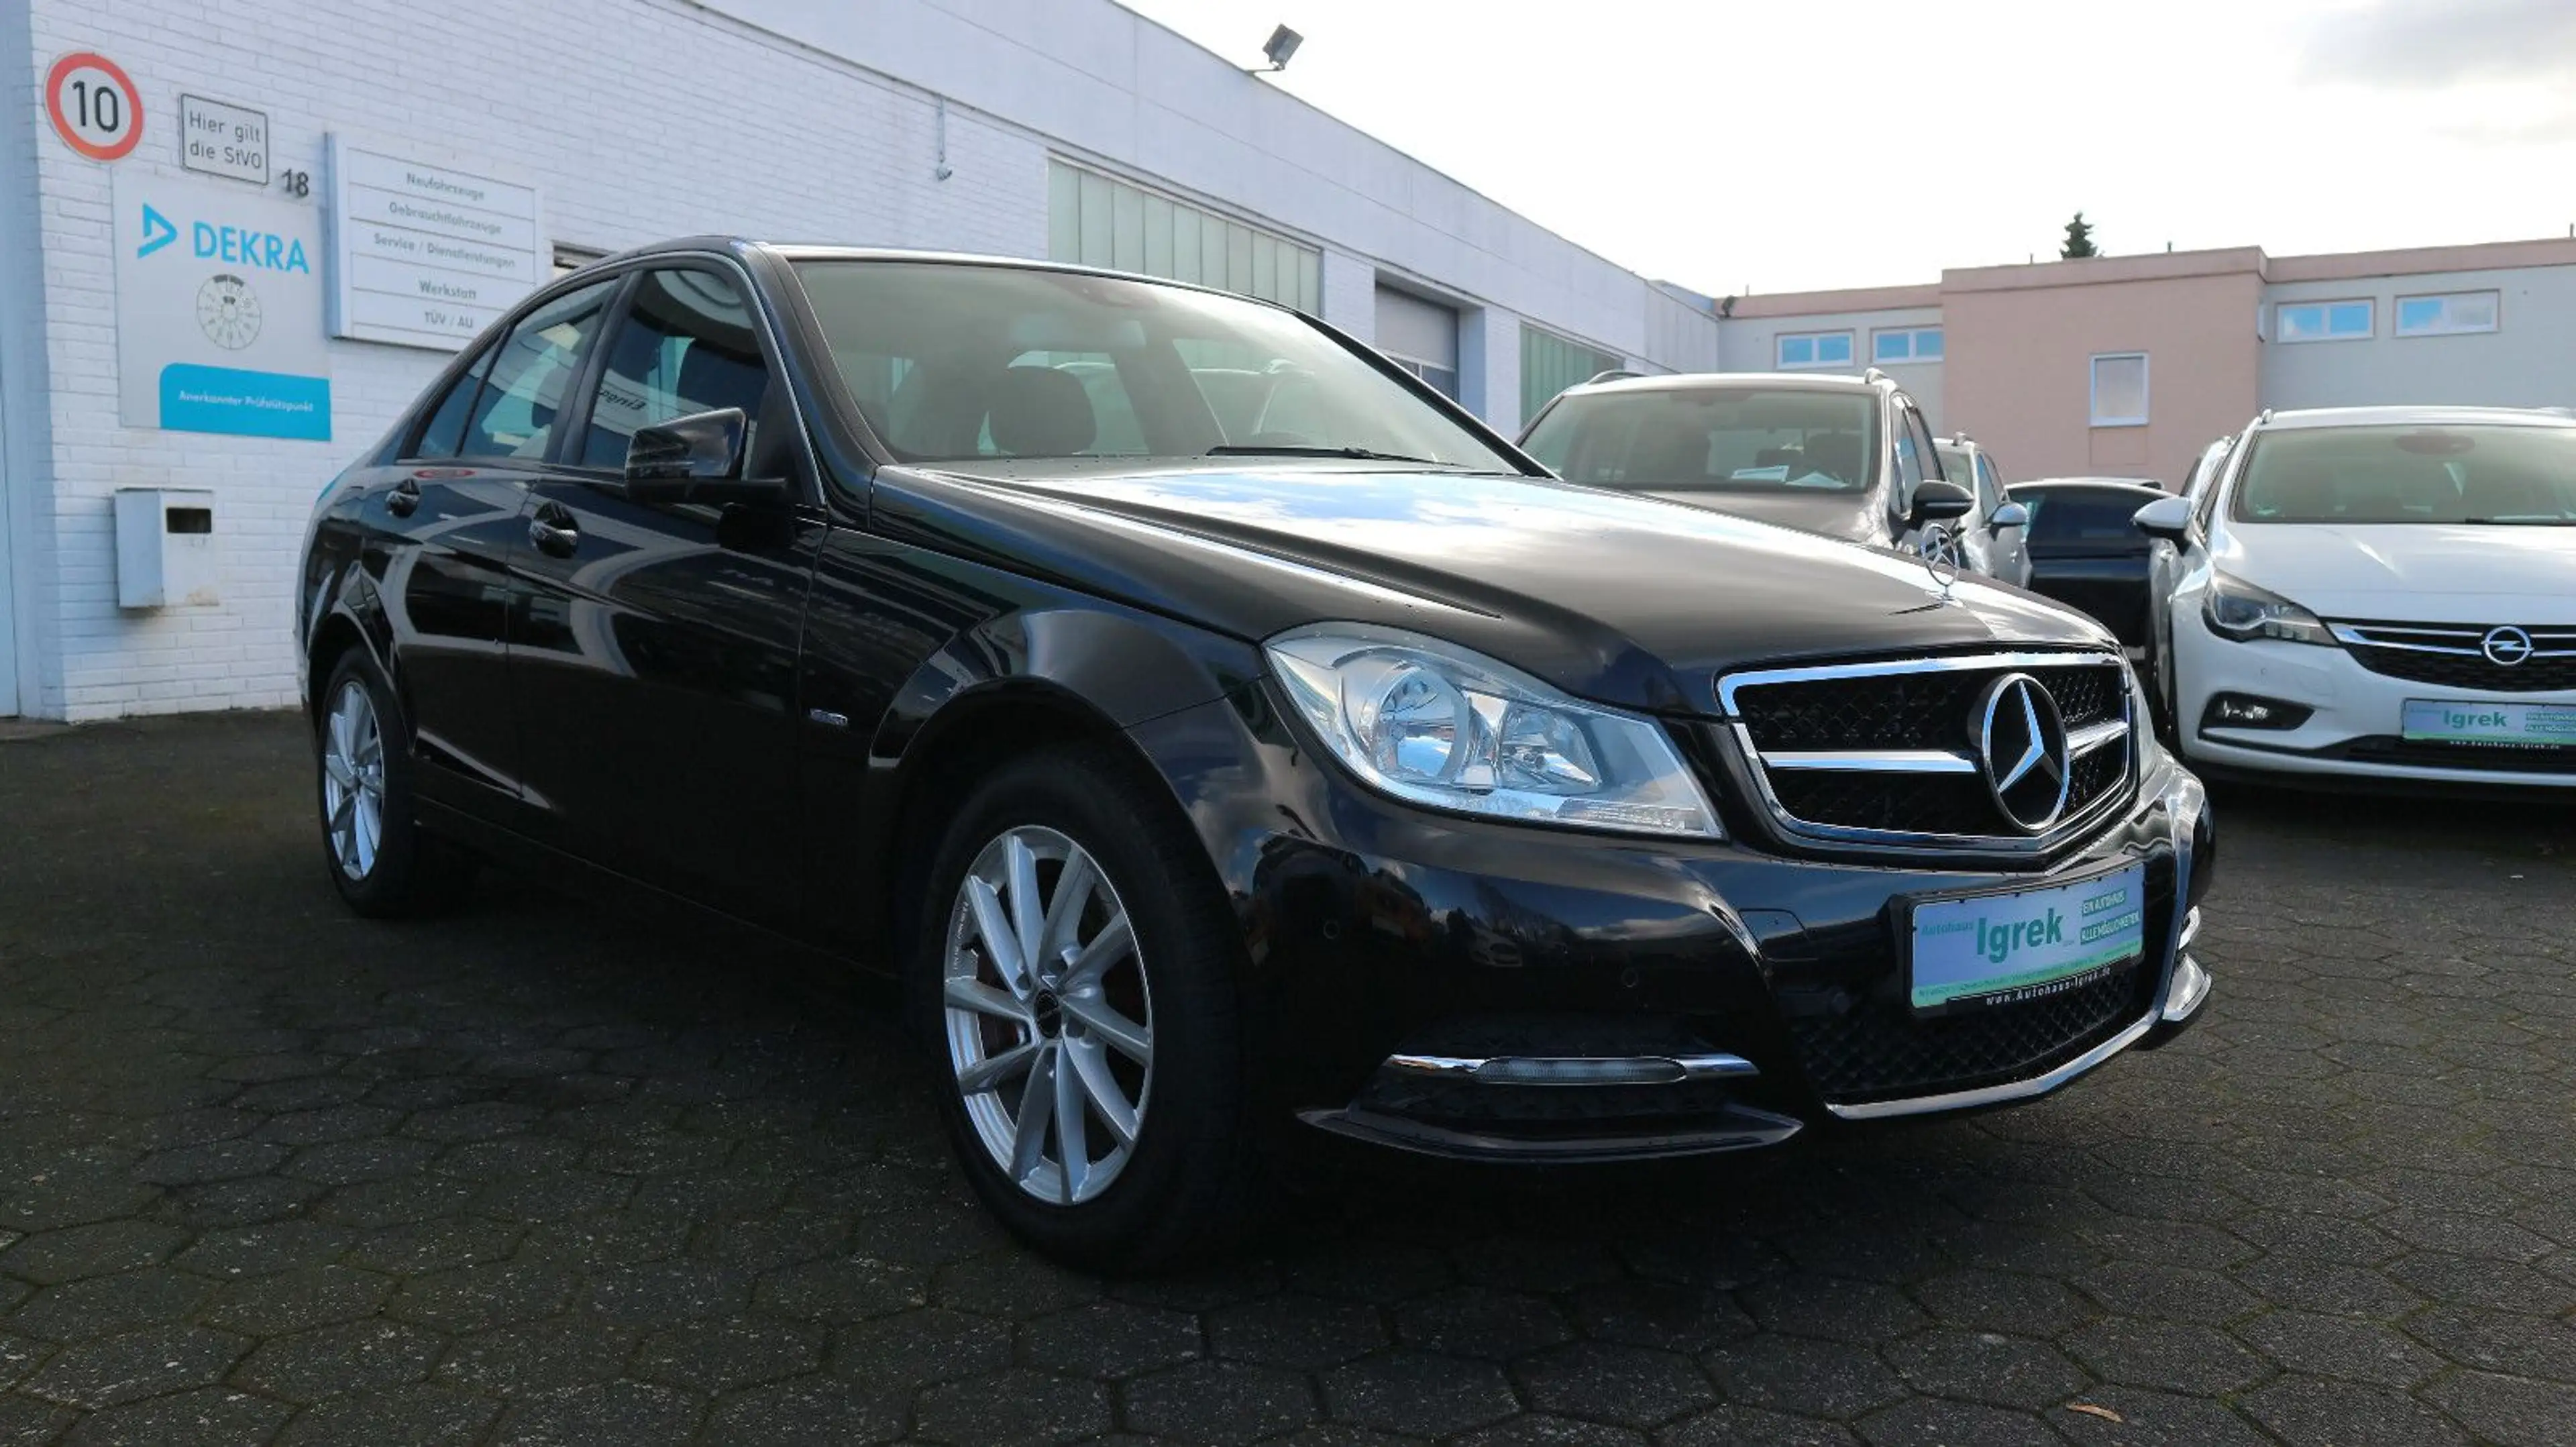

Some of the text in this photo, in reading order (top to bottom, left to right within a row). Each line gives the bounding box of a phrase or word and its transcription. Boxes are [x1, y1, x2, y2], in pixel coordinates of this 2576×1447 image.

[72, 80, 119, 133] 10
[189, 110, 260, 143] Hier gilt
[189, 140, 262, 169] die StVO
[282, 168, 309, 197] 18
[407, 172, 485, 201] Neufahrzeuge
[389, 201, 502, 235] Gebrauchtfahrzeuge
[193, 220, 310, 274] DEKRA
[374, 232, 415, 251] Service
[418, 279, 477, 299] Werkstatt
[425, 309, 446, 325] TÜV
[457, 315, 474, 329] AU
[2443, 710, 2508, 729] Igrek
[1921, 920, 1974, 935] Autohaus
[1976, 908, 2063, 963] Igrek
